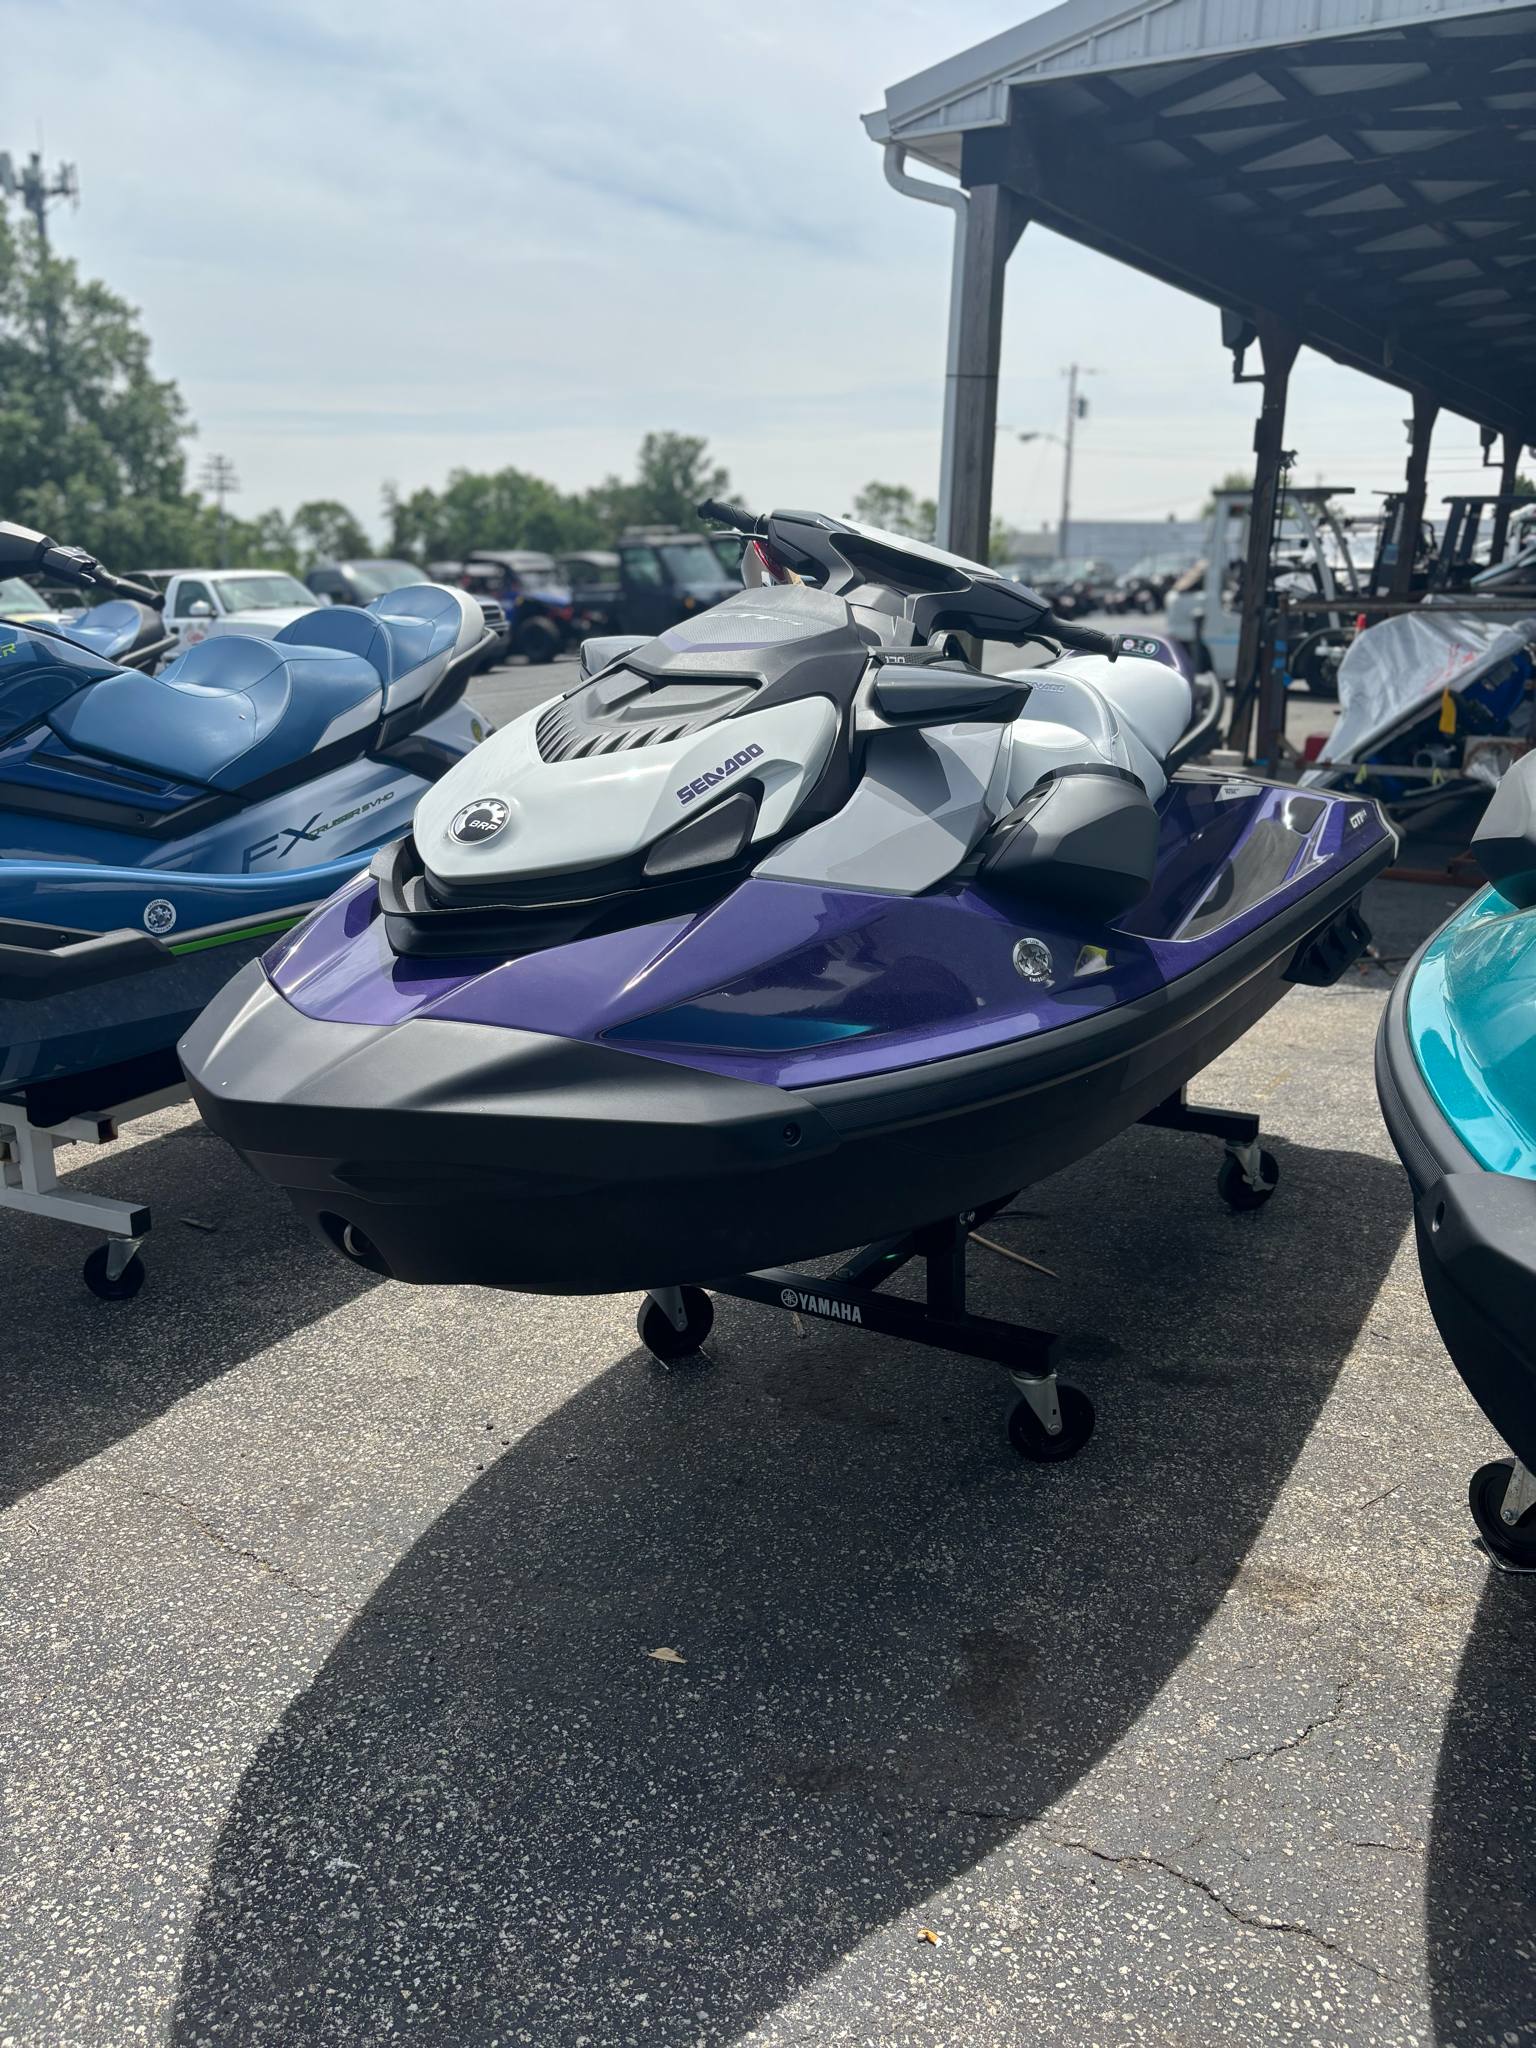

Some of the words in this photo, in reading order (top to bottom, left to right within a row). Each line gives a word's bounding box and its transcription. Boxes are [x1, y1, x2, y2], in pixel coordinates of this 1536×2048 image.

[241, 811, 323, 874] FX
[307, 807, 361, 840] CRUISER
[361, 791, 395, 813] SVHO
[469, 819, 498, 831] BRP
[799, 1292, 862, 1323] YAMAHA
